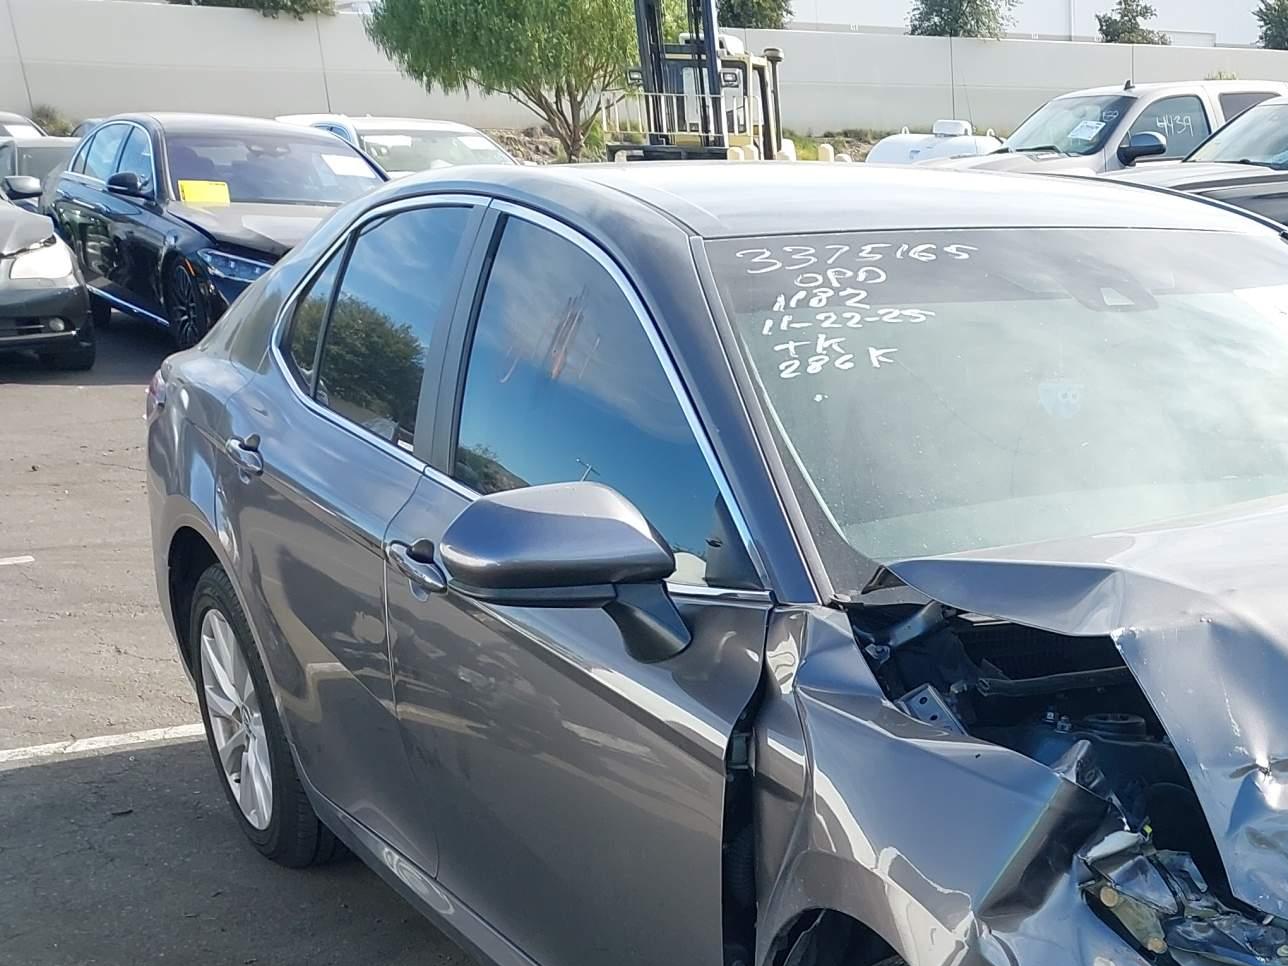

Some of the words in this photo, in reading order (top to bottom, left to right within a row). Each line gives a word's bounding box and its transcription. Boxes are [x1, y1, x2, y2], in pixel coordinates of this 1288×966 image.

[1156, 112, 1194, 137] 4439
[735, 243, 979, 274] 3375165
[794, 266, 887, 288] OPD
[761, 308, 936, 336] 11-22-25
